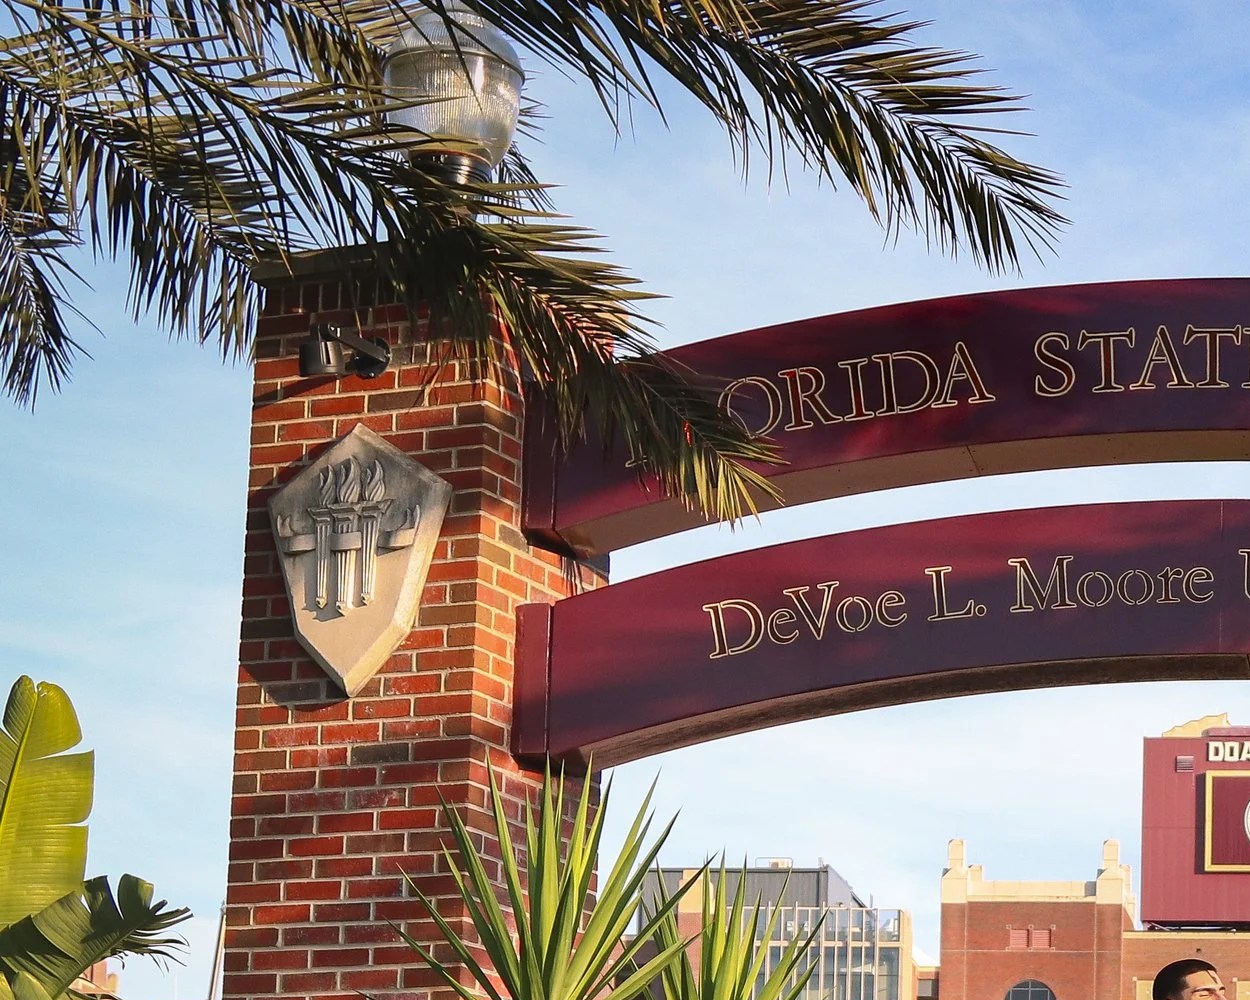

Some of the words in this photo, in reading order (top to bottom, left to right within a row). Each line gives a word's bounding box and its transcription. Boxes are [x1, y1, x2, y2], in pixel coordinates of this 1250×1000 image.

[624, 342, 996, 468] ORIDA
[702, 580, 908, 660] DeVoe
[923, 566, 987, 622] L.
[1007, 555, 1214, 613] Moore
